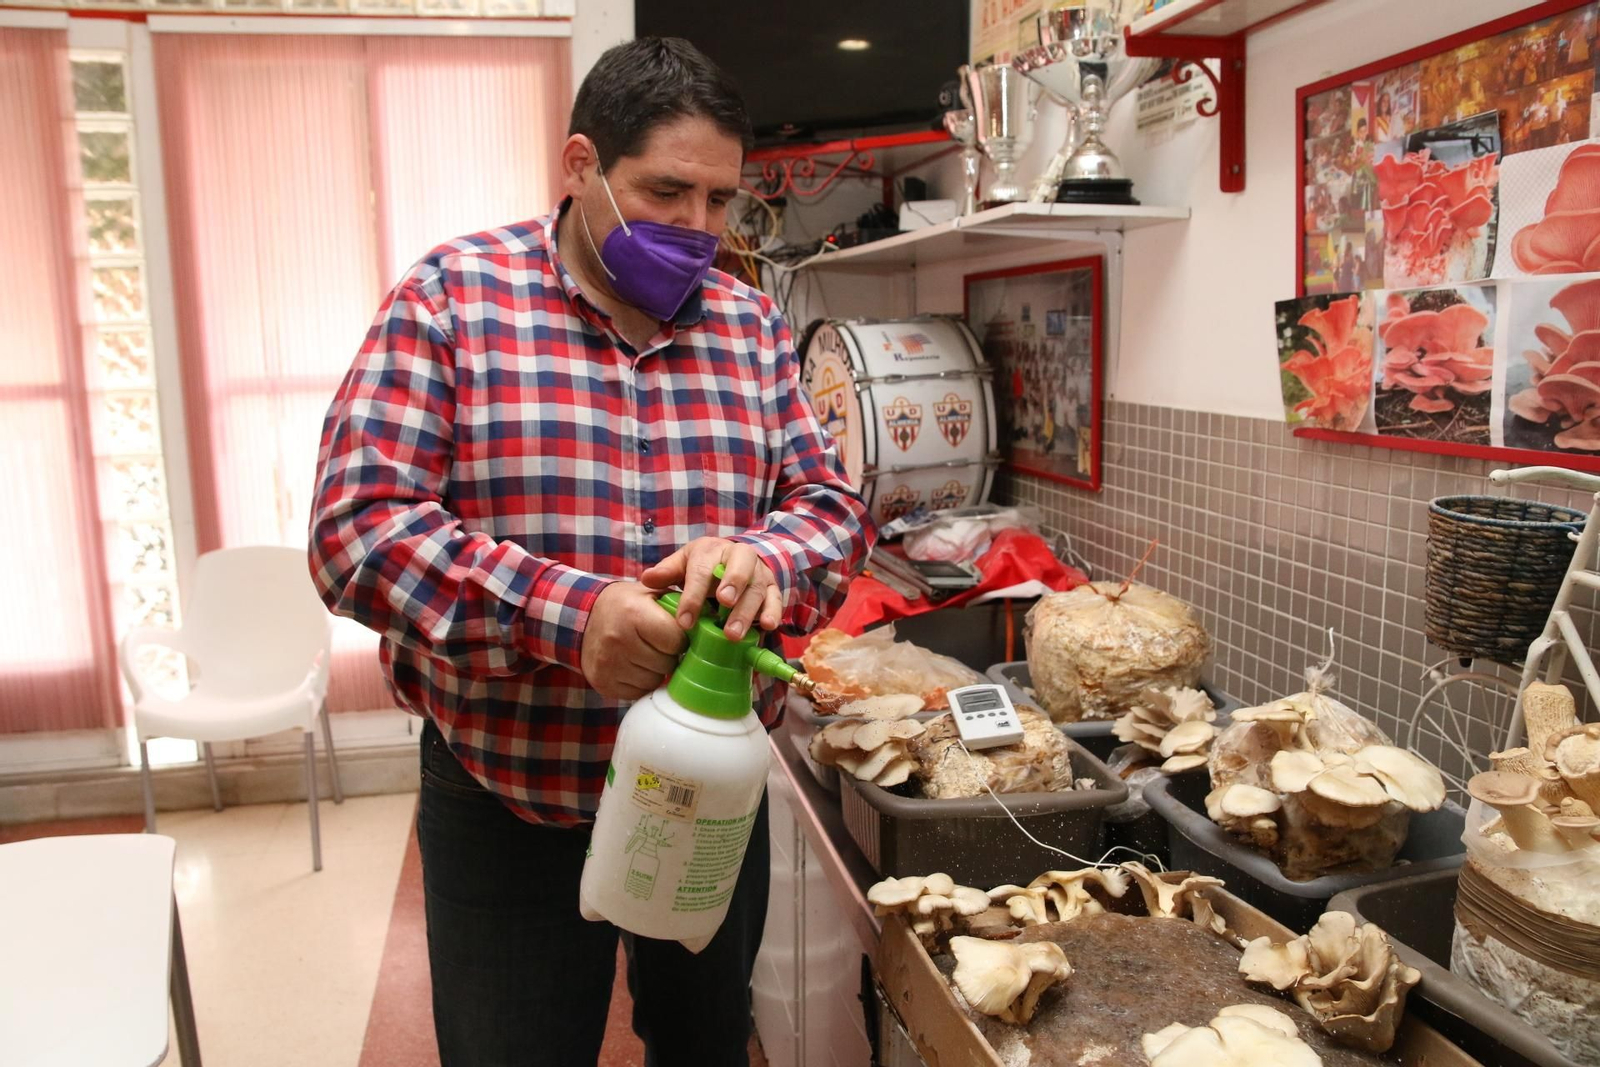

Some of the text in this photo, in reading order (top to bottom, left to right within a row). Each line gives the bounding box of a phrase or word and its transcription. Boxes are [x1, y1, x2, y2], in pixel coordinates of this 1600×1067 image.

[818, 392, 843, 416] U D
[959, 403, 967, 411] D
[886, 409, 895, 417] U
[696, 818, 736, 826] OPERATION
[677, 885, 717, 893] ATTENTION
